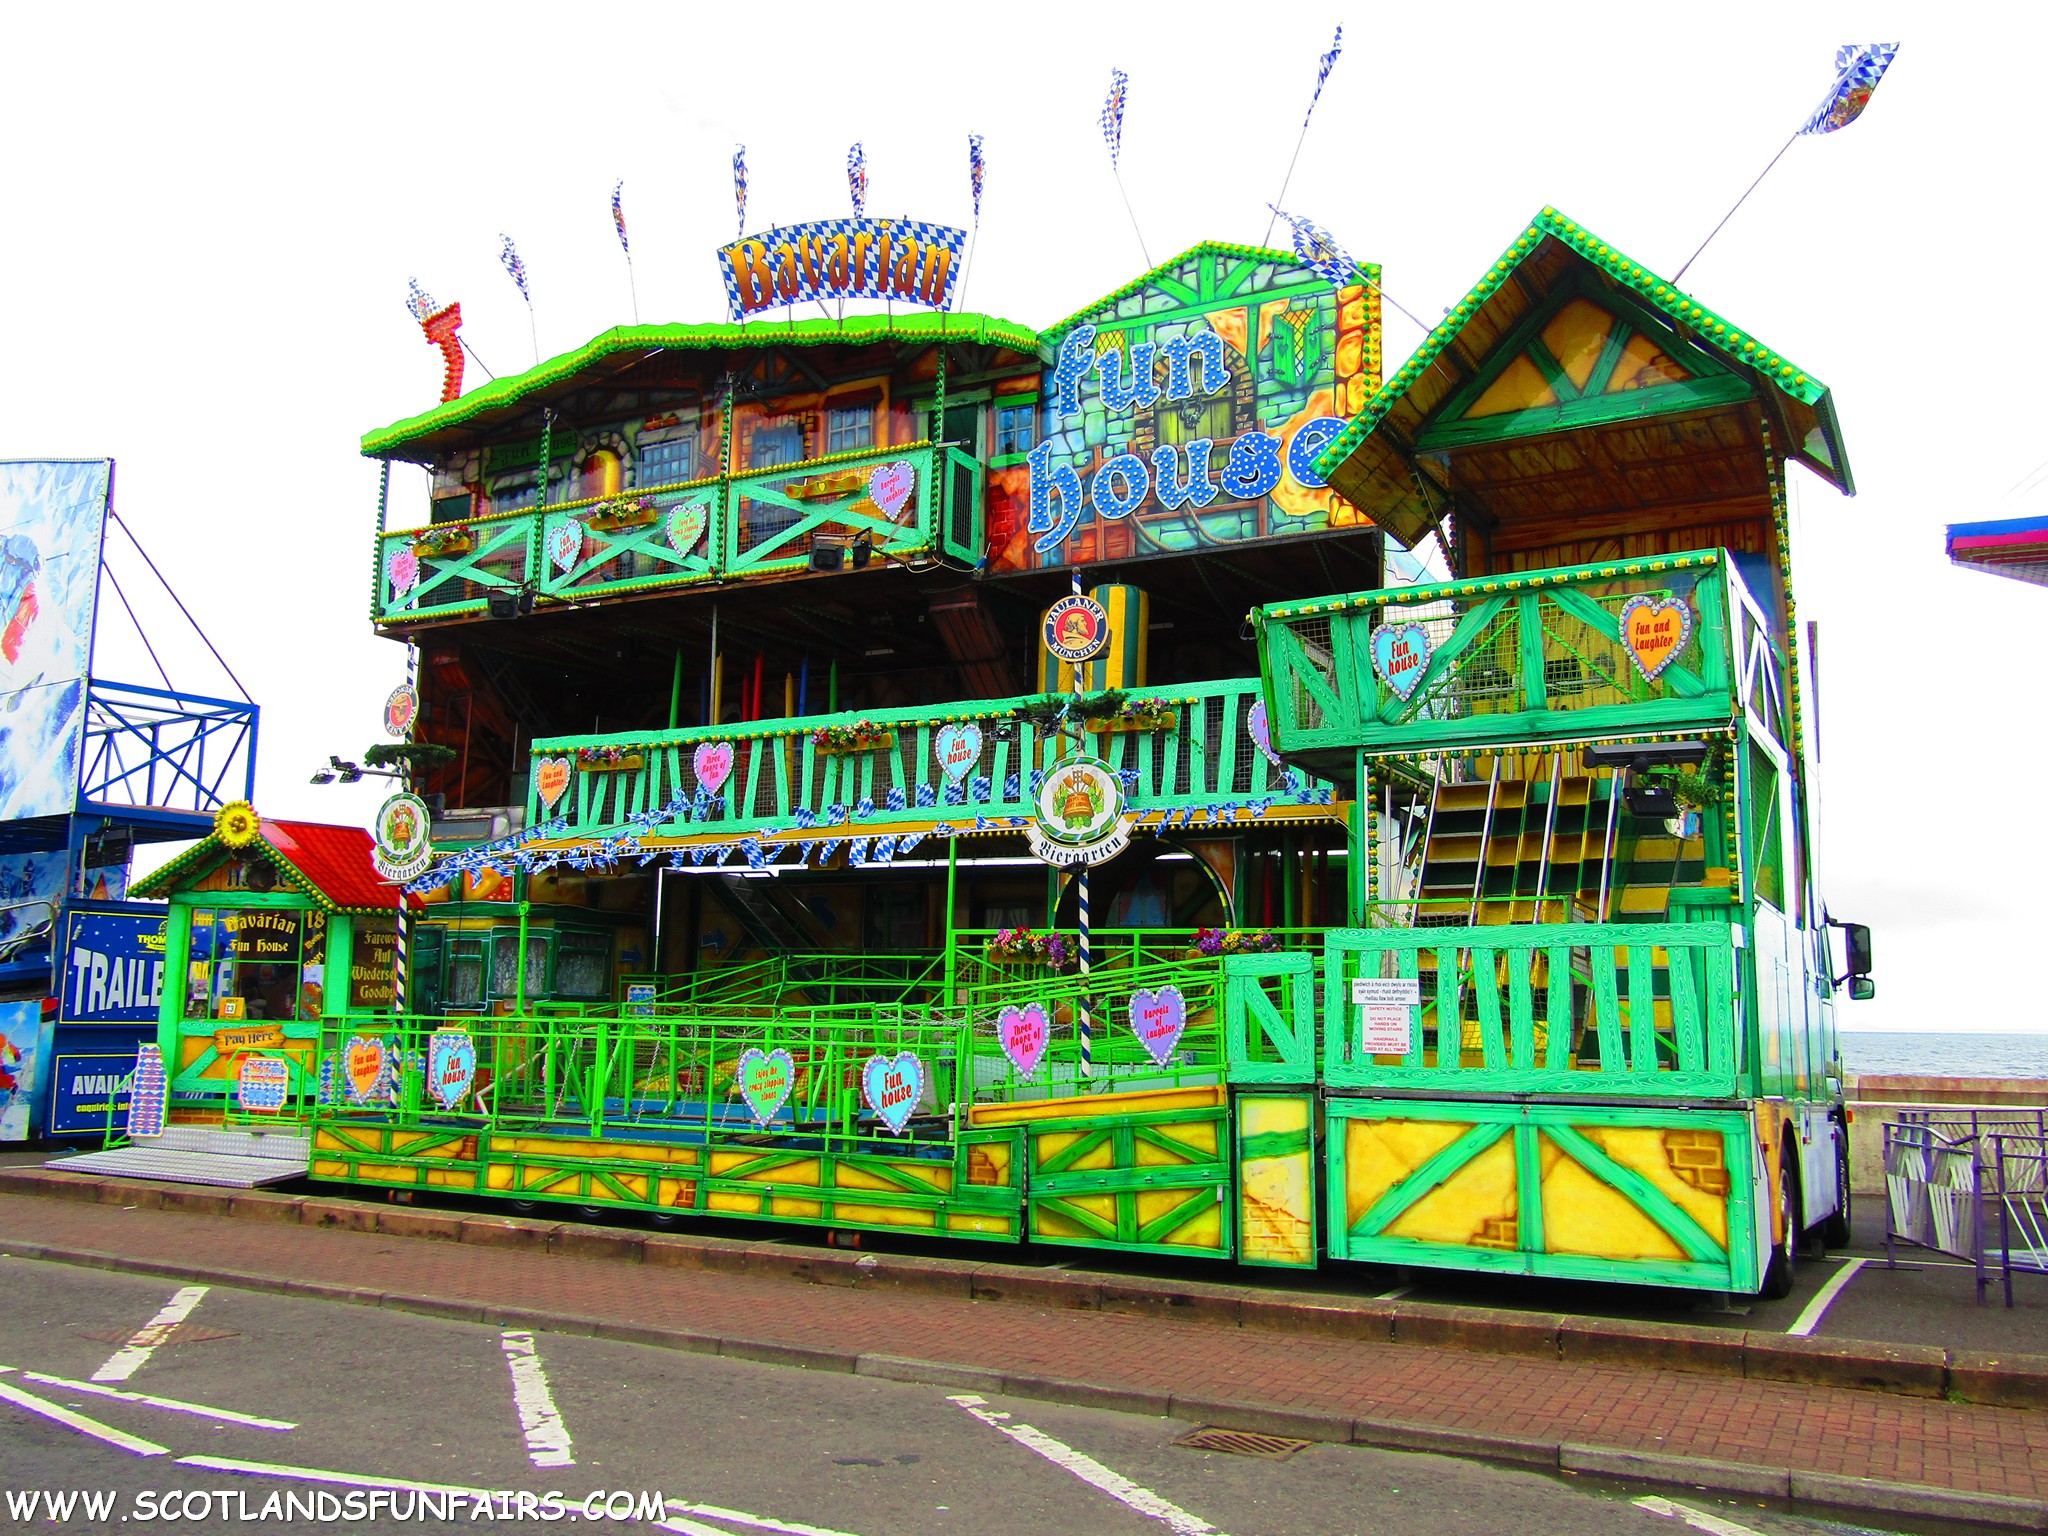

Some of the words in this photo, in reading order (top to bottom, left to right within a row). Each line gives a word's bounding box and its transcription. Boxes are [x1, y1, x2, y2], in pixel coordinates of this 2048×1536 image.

[723, 219, 951, 314] Bavarian
[1053, 324, 1232, 419] fun
[1026, 416, 1351, 553] house
[559, 540, 577, 560] house
[560, 534, 571, 549] Fun
[1046, 598, 1104, 626] PAULANER
[1635, 621, 1651, 636] Fun
[1653, 618, 1670, 633] and
[1391, 640, 1410, 660] Fun
[1634, 635, 1674, 652] Laughter
[1388, 650, 1419, 677] house
[951, 738, 966, 752] Fun
[947, 748, 972, 765] house
[223, 912, 297, 934] Bavarian
[306, 910, 325, 929] 18
[229, 939, 250, 952] Fun
[256, 938, 289, 953] House
[371, 947, 392, 963] Auf
[1143, 1004, 1169, 1020] Barrels
[1013, 1022, 1032, 1037] Three
[1155, 1015, 1163, 1027] of
[225, 1034, 246, 1046] Pay
[248, 1032, 274, 1044] Here
[1010, 1033, 1031, 1050] floors
[1033, 1027, 1041, 1040] of
[1145, 1024, 1176, 1040] Laughter
[354, 1055, 364, 1065] Fun
[365, 1051, 377, 1062] and
[1021, 1043, 1034, 1056] fun
[353, 1064, 379, 1077] Laughter
[447, 1056, 461, 1071] Fun
[442, 1069, 466, 1086] house
[884, 1071, 903, 1091] Fun
[881, 1084, 912, 1109] house
